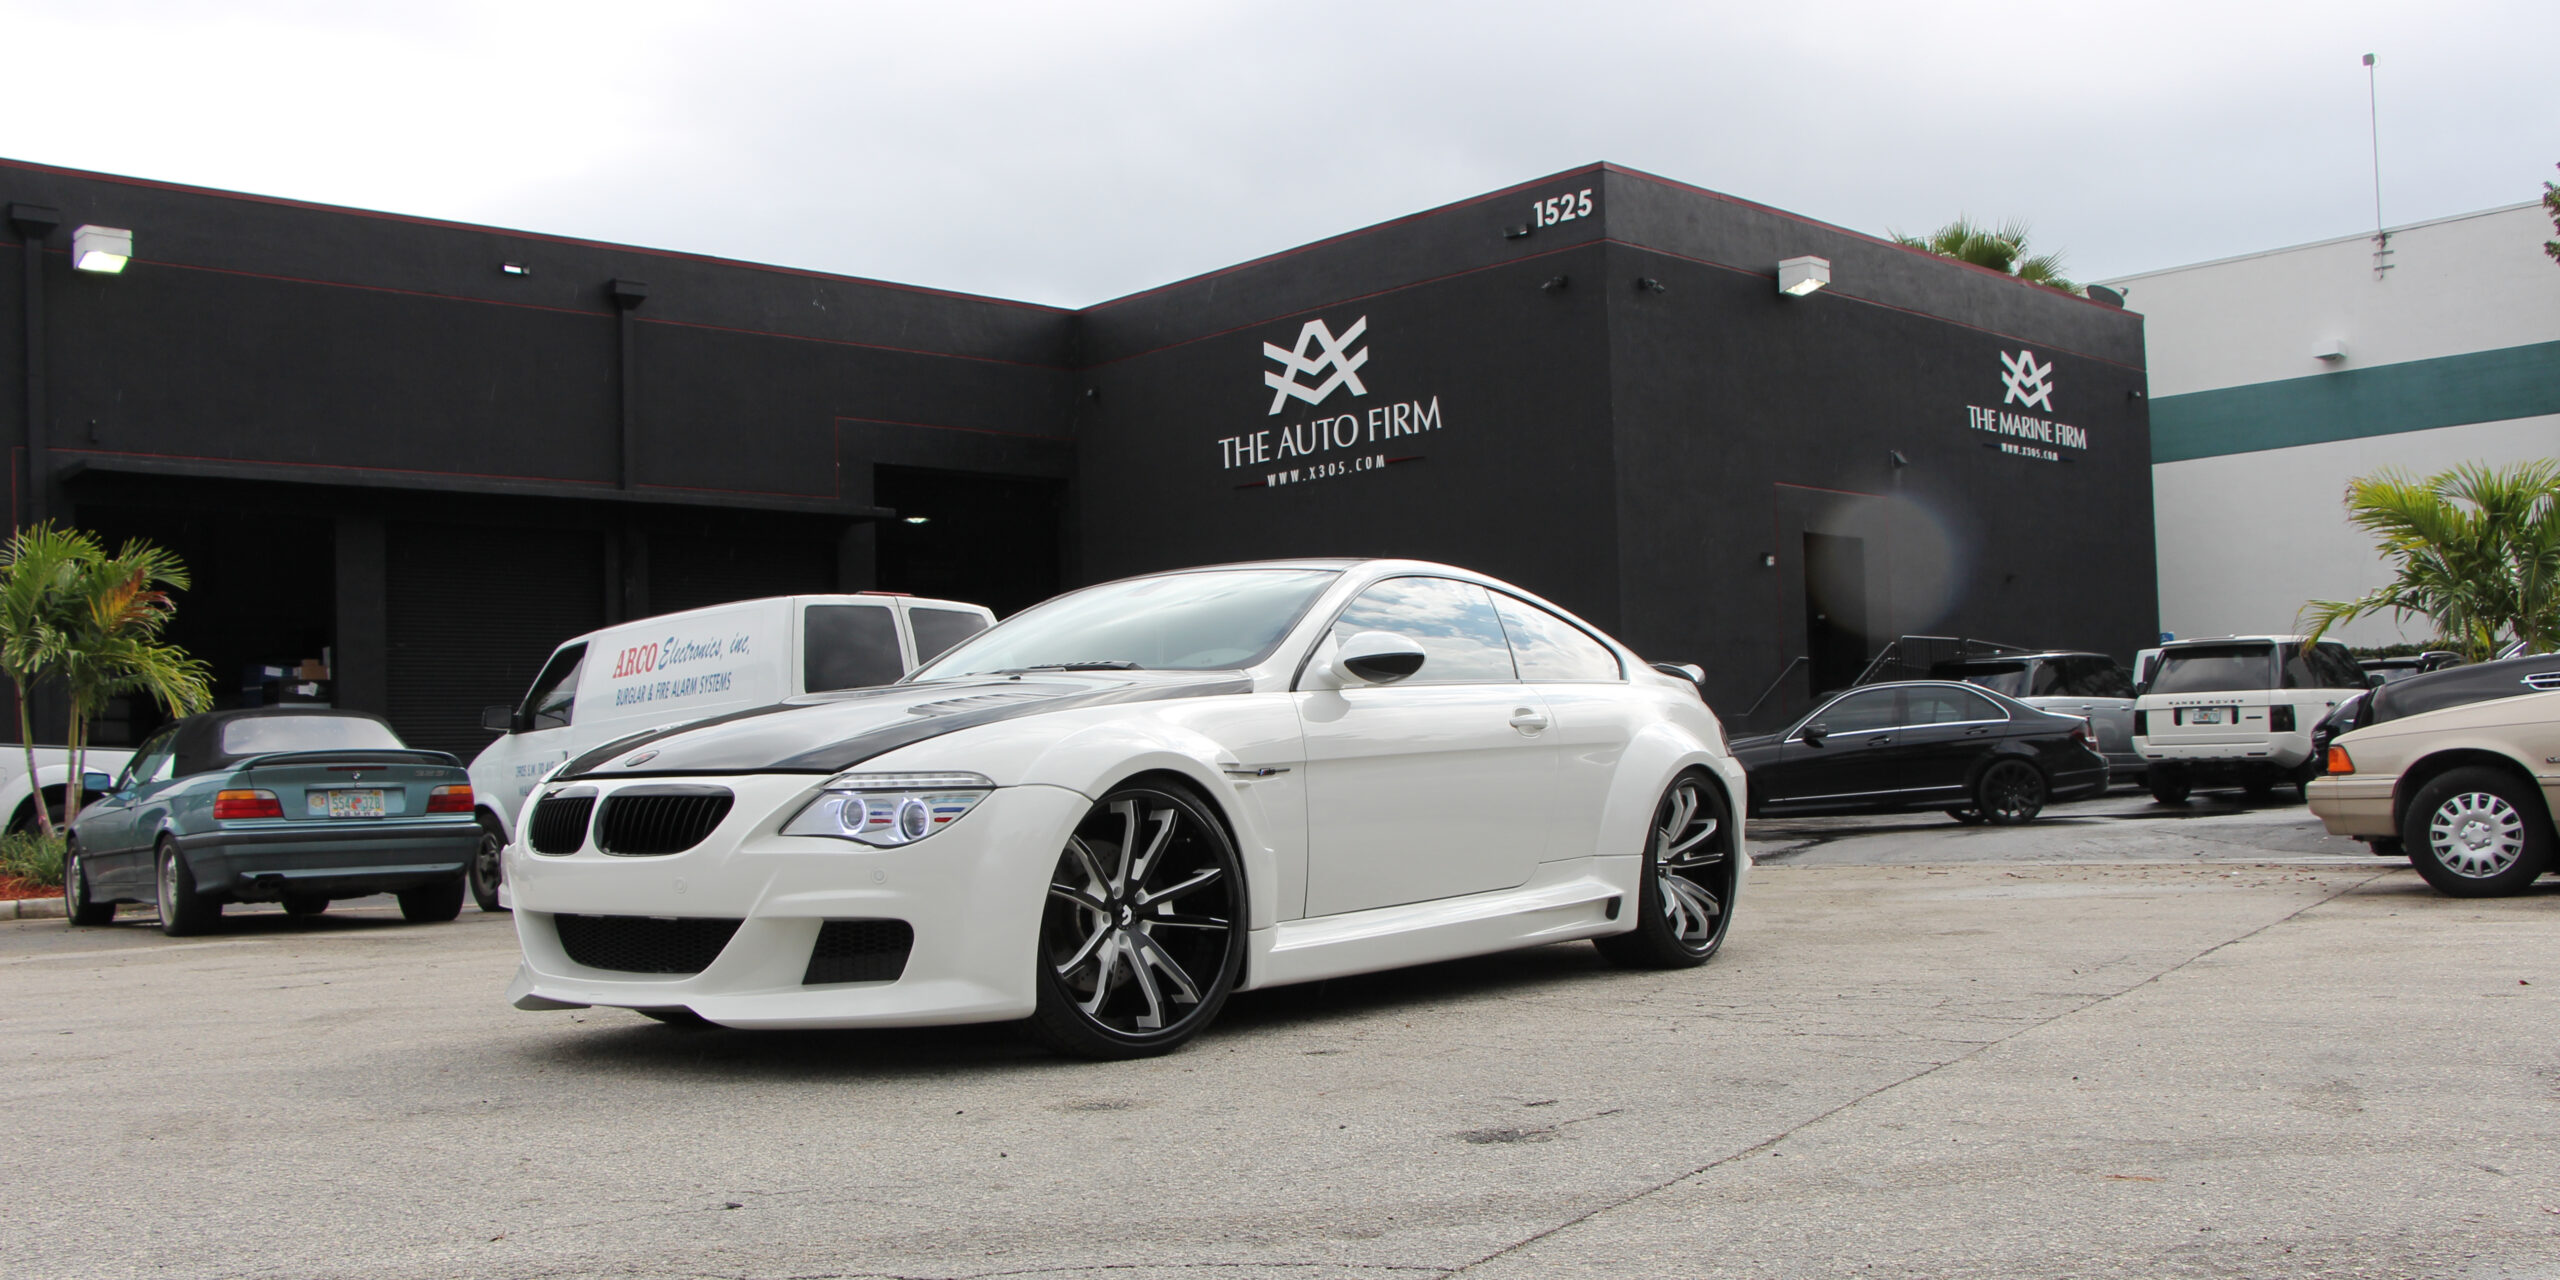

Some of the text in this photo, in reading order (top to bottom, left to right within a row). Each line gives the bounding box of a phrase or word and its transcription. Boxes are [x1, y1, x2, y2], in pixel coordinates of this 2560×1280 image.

[1533, 188, 1593, 228] 1525
[1218, 395, 1442, 469] THE AUTO FIRM
[1966, 405, 2088, 450] THE MARINE FIRM
[1267, 454, 1385, 487] WWW.X305.COM
[2001, 442, 2059, 462] WWW.X305.COM
[612, 642, 658, 679] ARCO
[615, 671, 732, 706] BURGLAR & FIRE ALARM SYSTEMS
